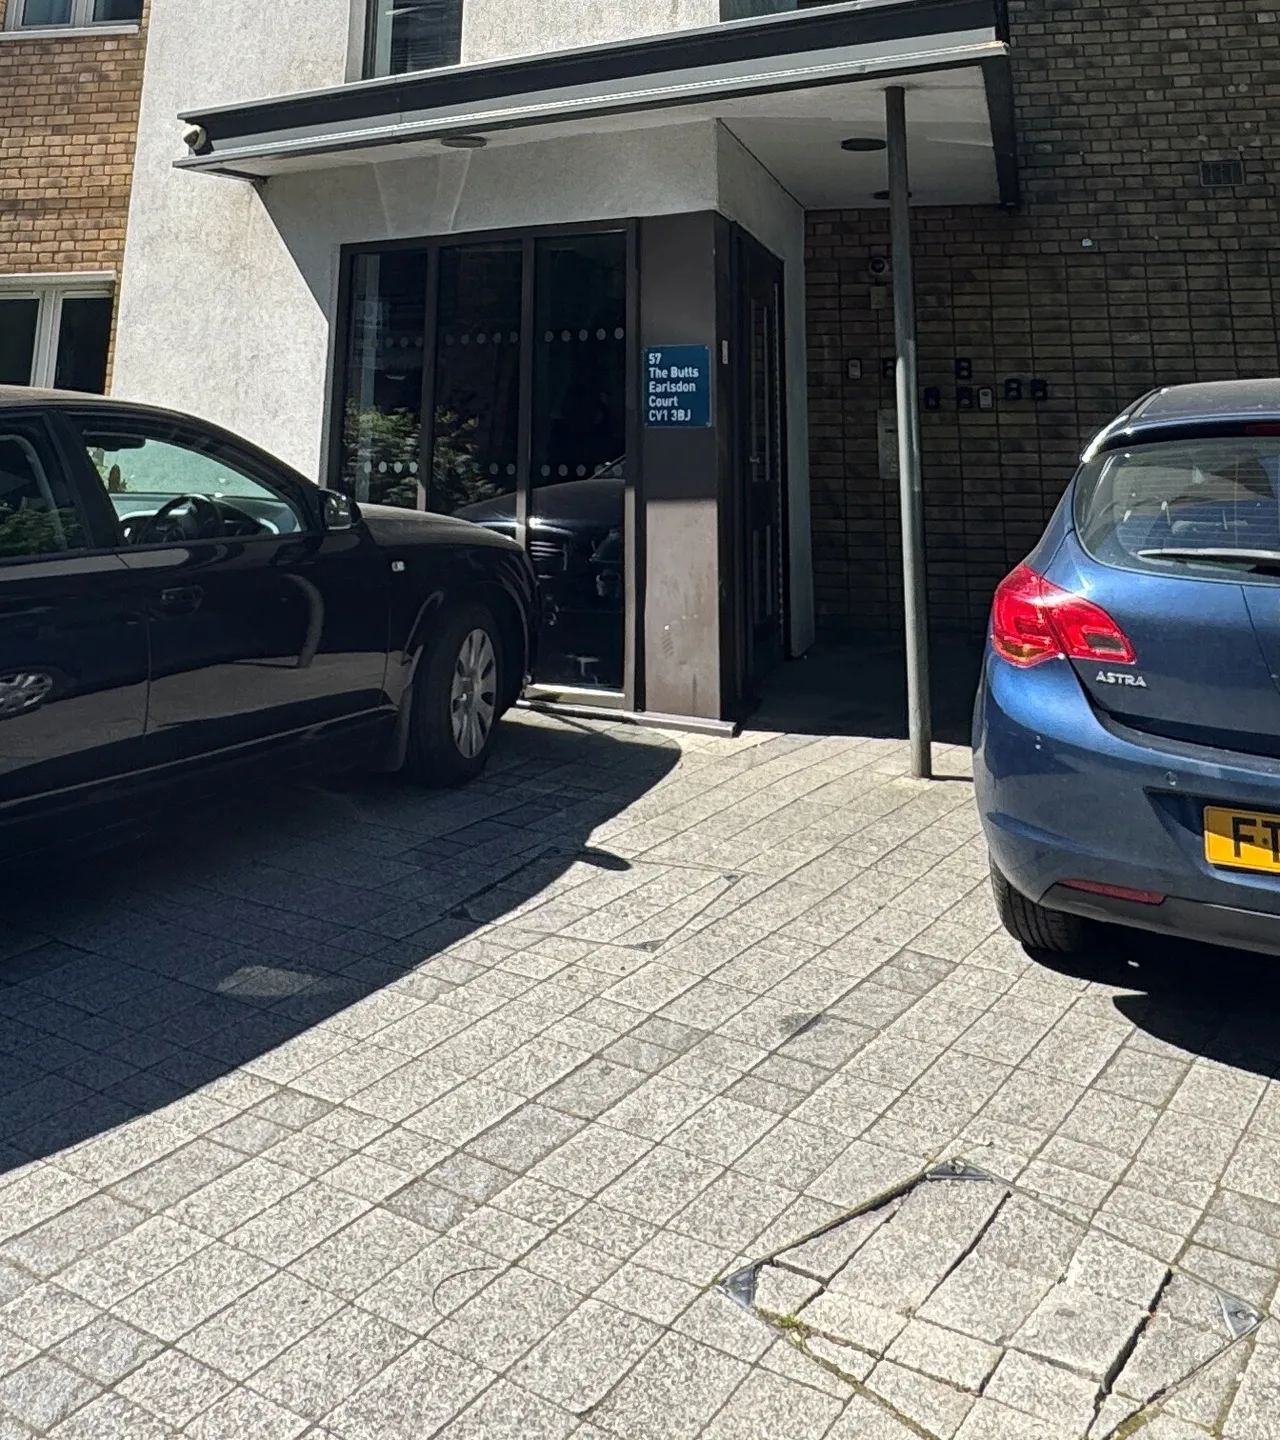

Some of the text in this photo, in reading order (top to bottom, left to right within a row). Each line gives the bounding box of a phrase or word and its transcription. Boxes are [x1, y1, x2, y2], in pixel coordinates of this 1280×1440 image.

[648, 352, 662, 365] 57
[648, 366, 699, 379] The Butts
[648, 380, 696, 393] Earlsdon
[648, 395, 678, 408] Court
[648, 409, 692, 422] CV1 3BJ
[1095, 670, 1147, 688] ASTRA
